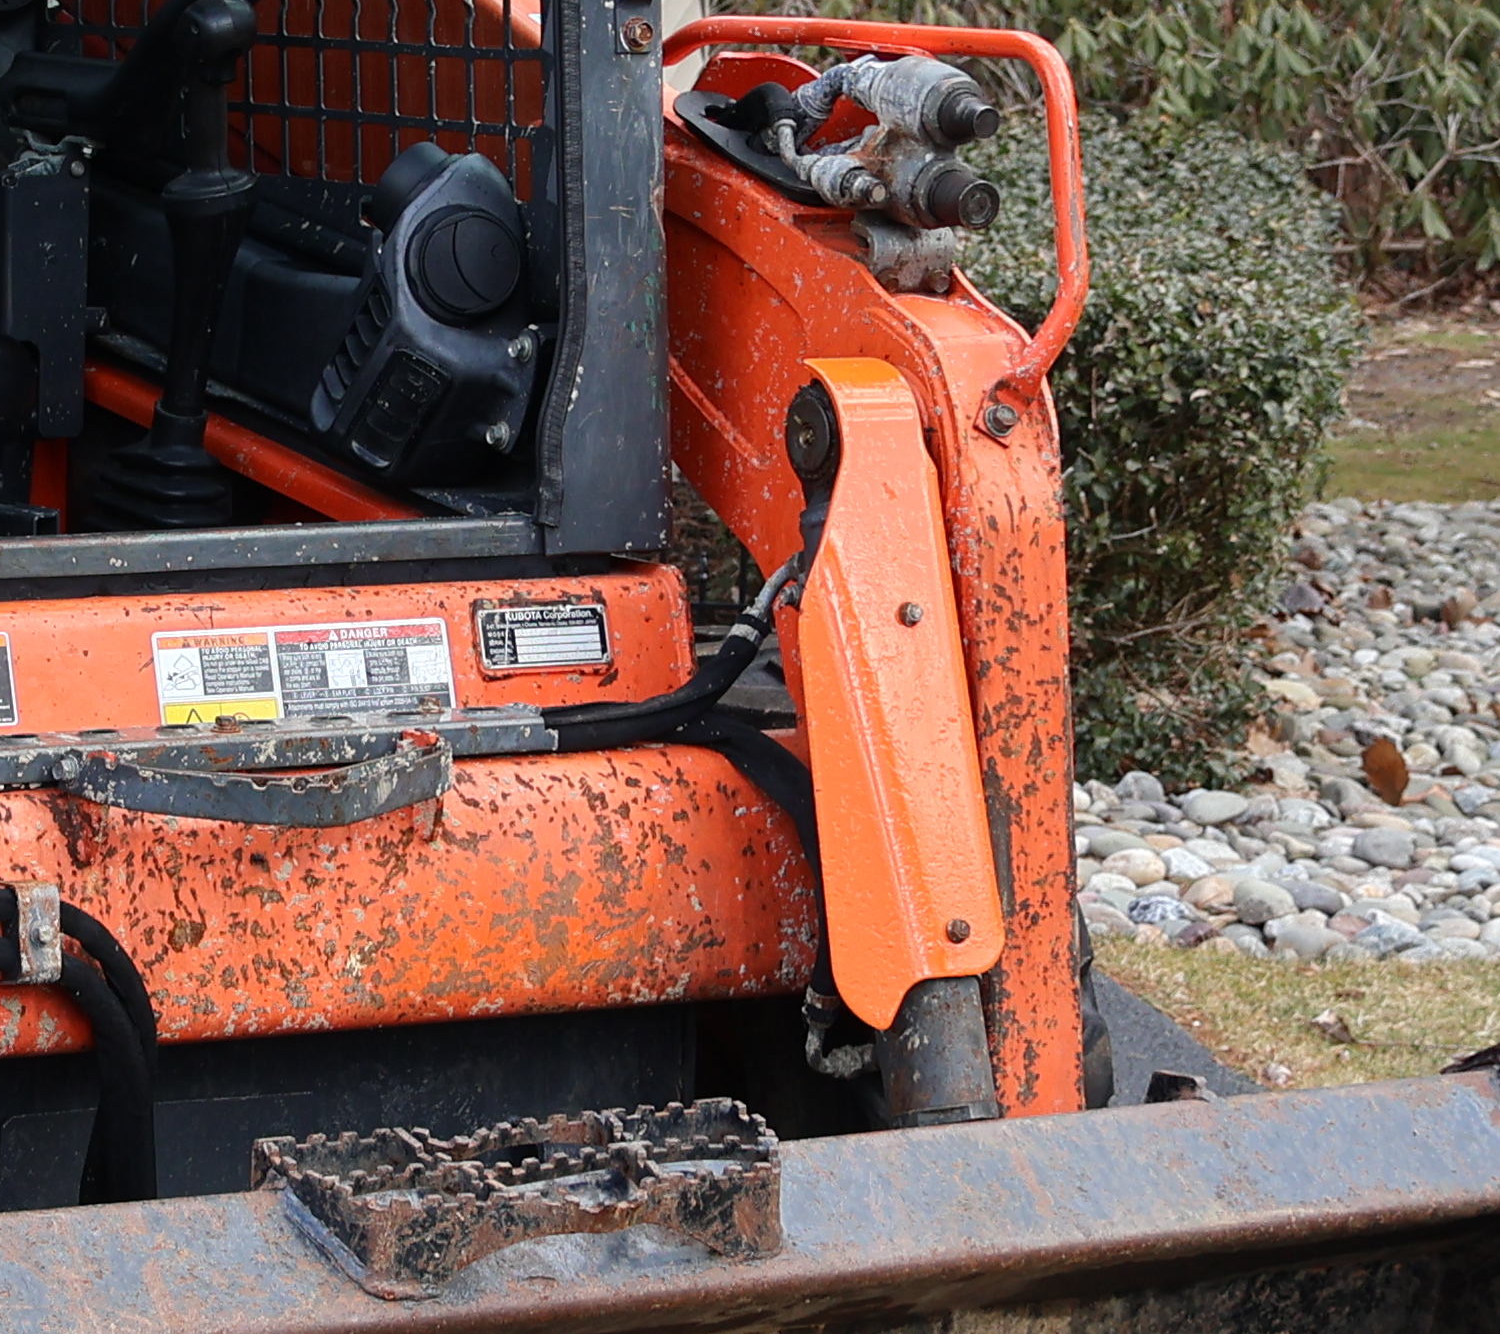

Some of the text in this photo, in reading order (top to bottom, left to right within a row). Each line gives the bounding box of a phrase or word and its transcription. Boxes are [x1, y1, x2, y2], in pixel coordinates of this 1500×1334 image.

[505, 611, 543, 622] KUBOTA
[340, 627, 389, 639] DANGER
[194, 636, 245, 647] WARNING
[330, 640, 363, 650] PERSONAL
